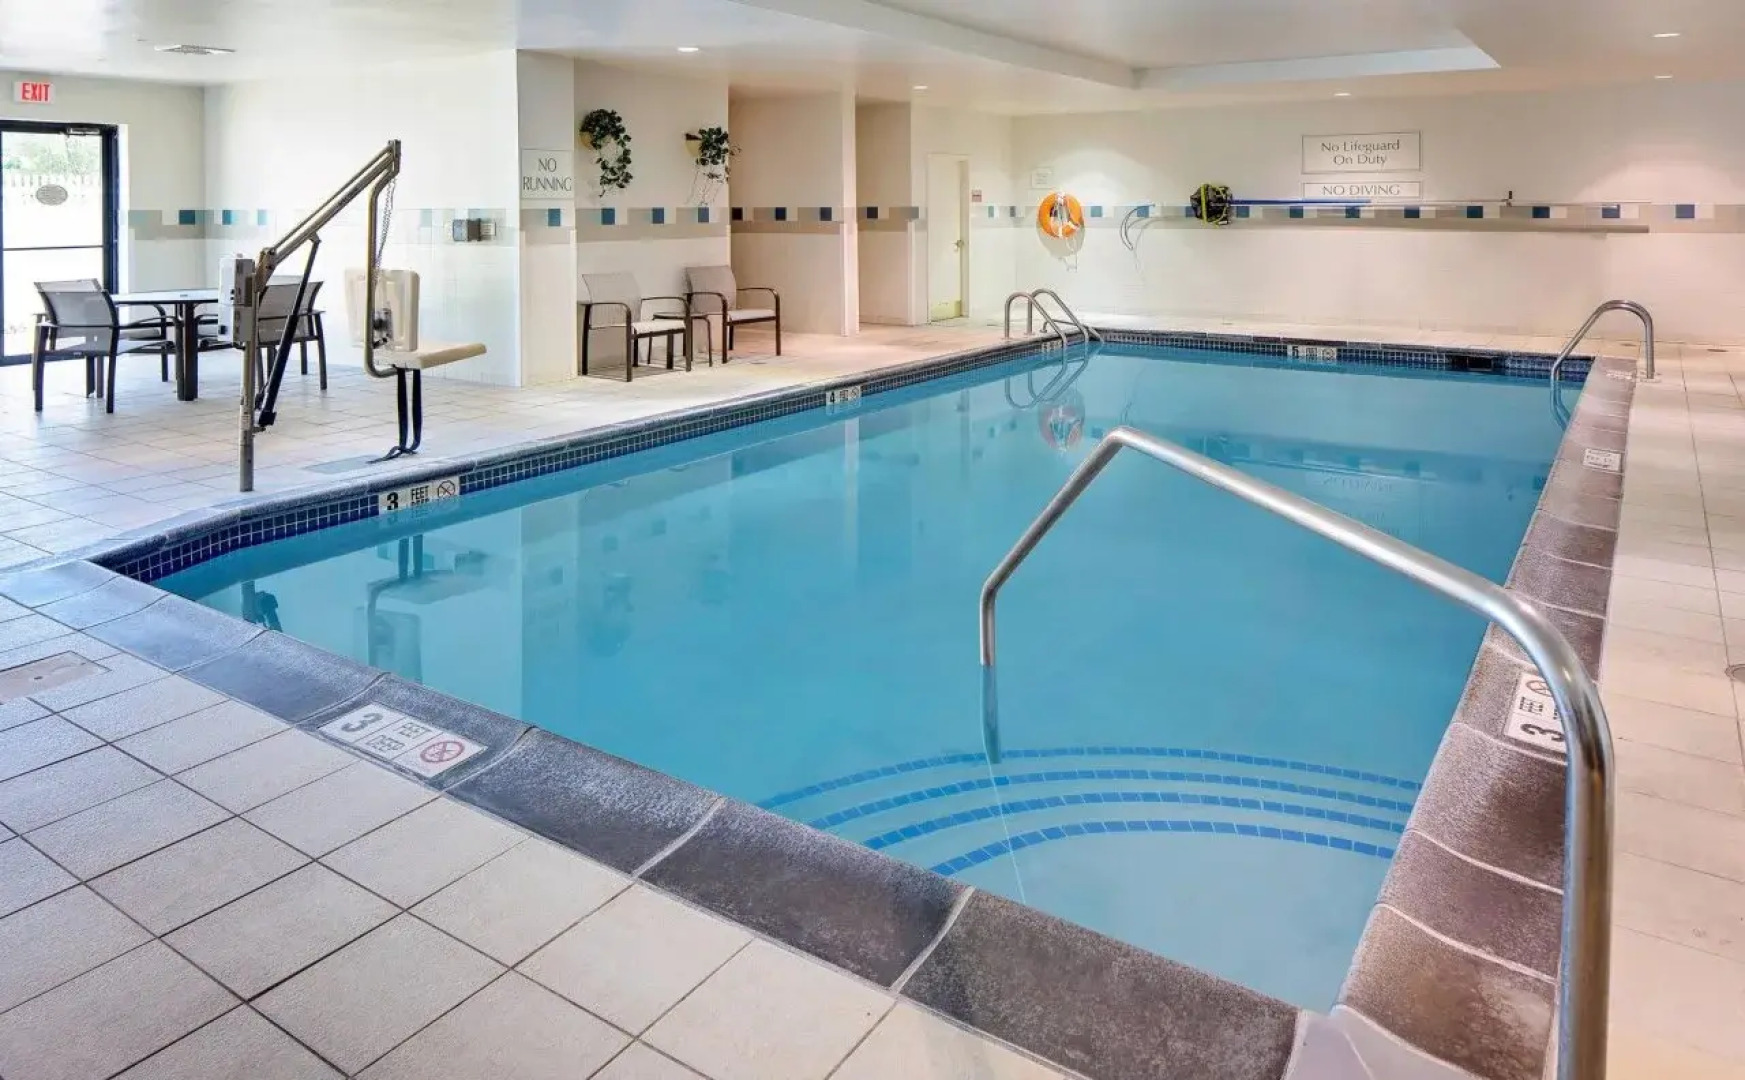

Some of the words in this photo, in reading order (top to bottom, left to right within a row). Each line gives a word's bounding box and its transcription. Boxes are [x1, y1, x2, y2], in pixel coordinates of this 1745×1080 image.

[22, 82, 50, 102] EXIT
[1321, 142, 1340, 152] No
[1343, 139, 1400, 154] Lifeguard
[538, 157, 557, 173] NO
[1333, 154, 1353, 165] On
[1357, 154, 1386, 167] Duty
[523, 176, 572, 192] RUNNING
[1323, 185, 1345, 196] NO
[1349, 184, 1400, 196] DIVING
[387, 491, 399, 511] 3
[411, 485, 429, 500] FEET
[341, 712, 384, 733] 3
[393, 721, 432, 740] FEET
[1521, 723, 1566, 743] 3
[365, 734, 406, 751] DEEP
